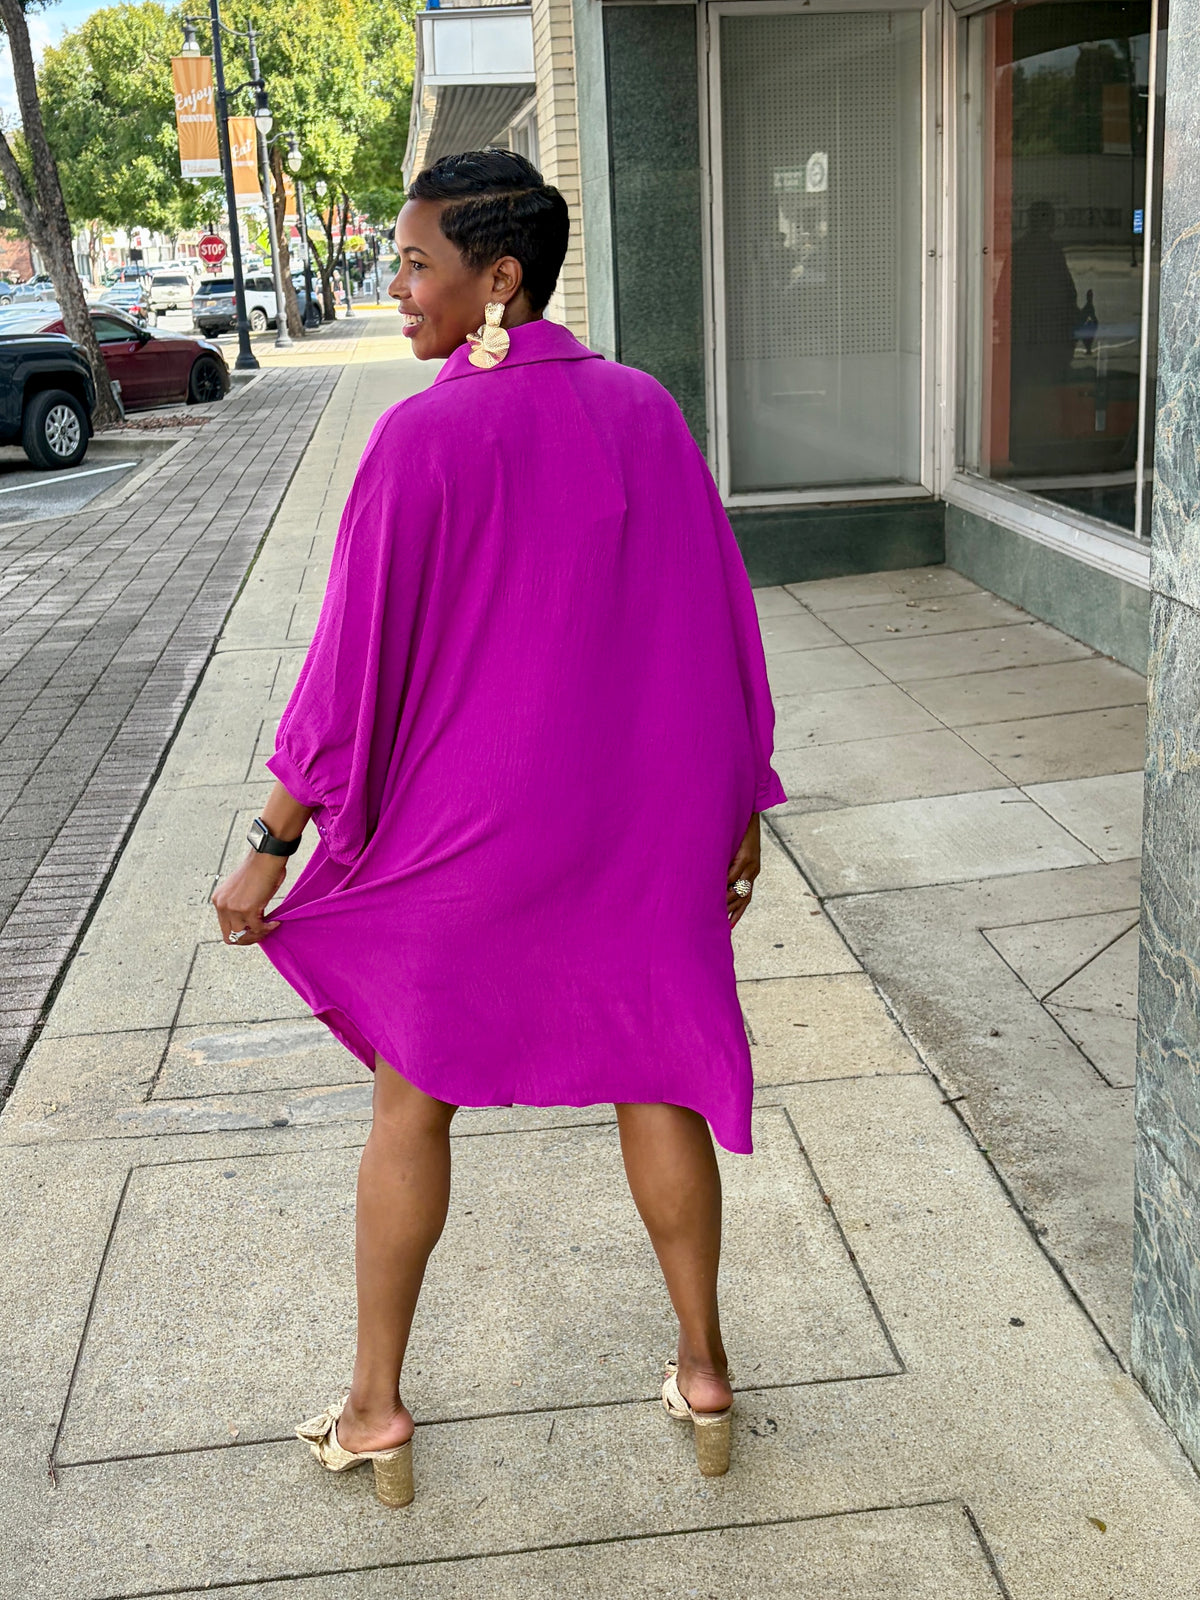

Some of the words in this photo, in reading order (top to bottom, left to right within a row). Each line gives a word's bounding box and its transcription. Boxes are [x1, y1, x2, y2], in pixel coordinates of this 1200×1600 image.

[174, 85, 215, 112] Enjoy
[231, 138, 254, 160] Eat
[201, 243, 225, 256] STOP
